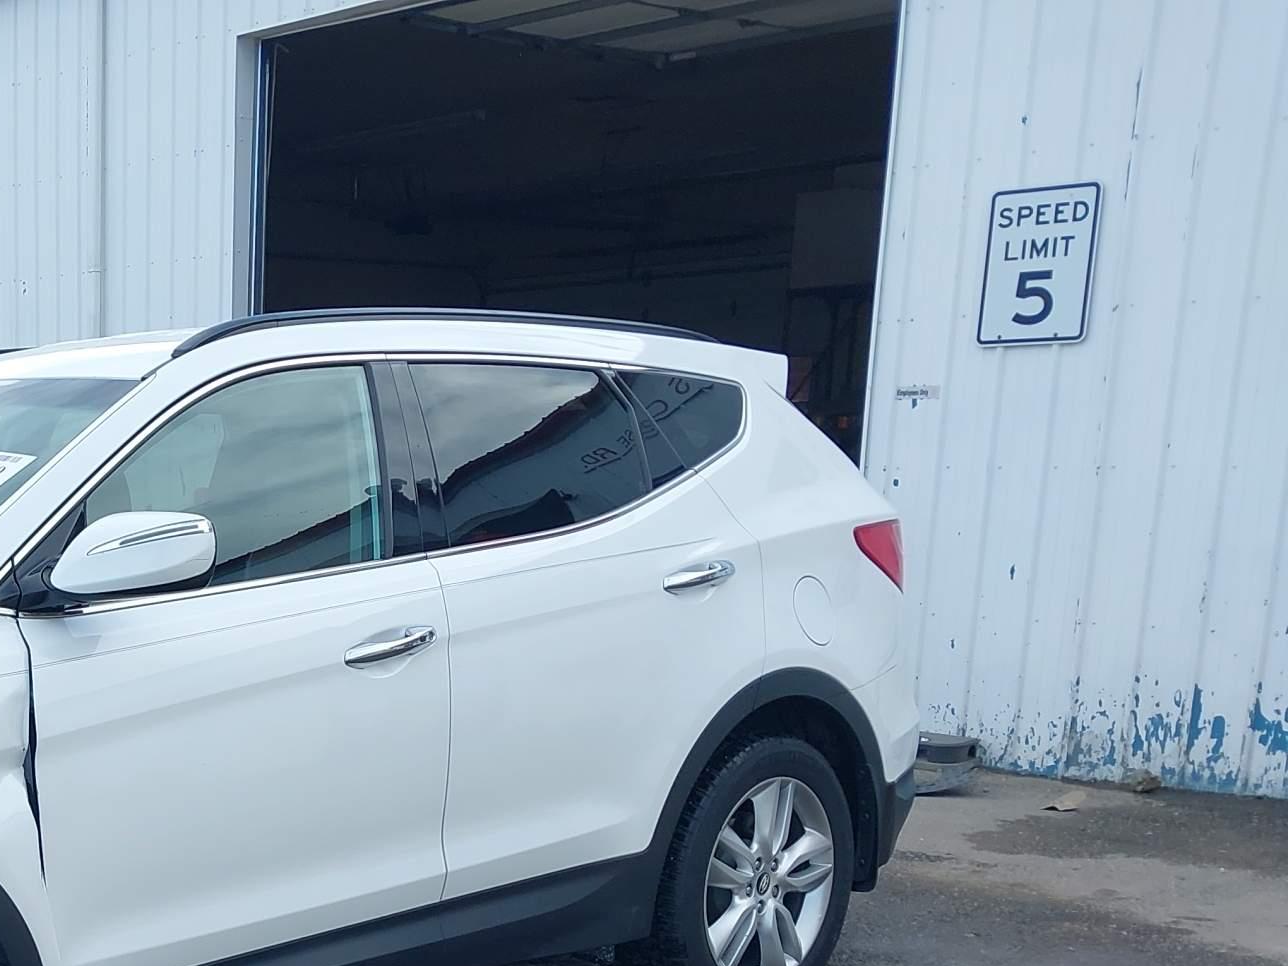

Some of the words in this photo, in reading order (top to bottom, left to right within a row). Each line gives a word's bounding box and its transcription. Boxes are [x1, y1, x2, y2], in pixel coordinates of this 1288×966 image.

[998, 200, 1090, 229] SPEED
[1004, 235, 1076, 262] LIMIT
[1011, 269, 1054, 326] 5
